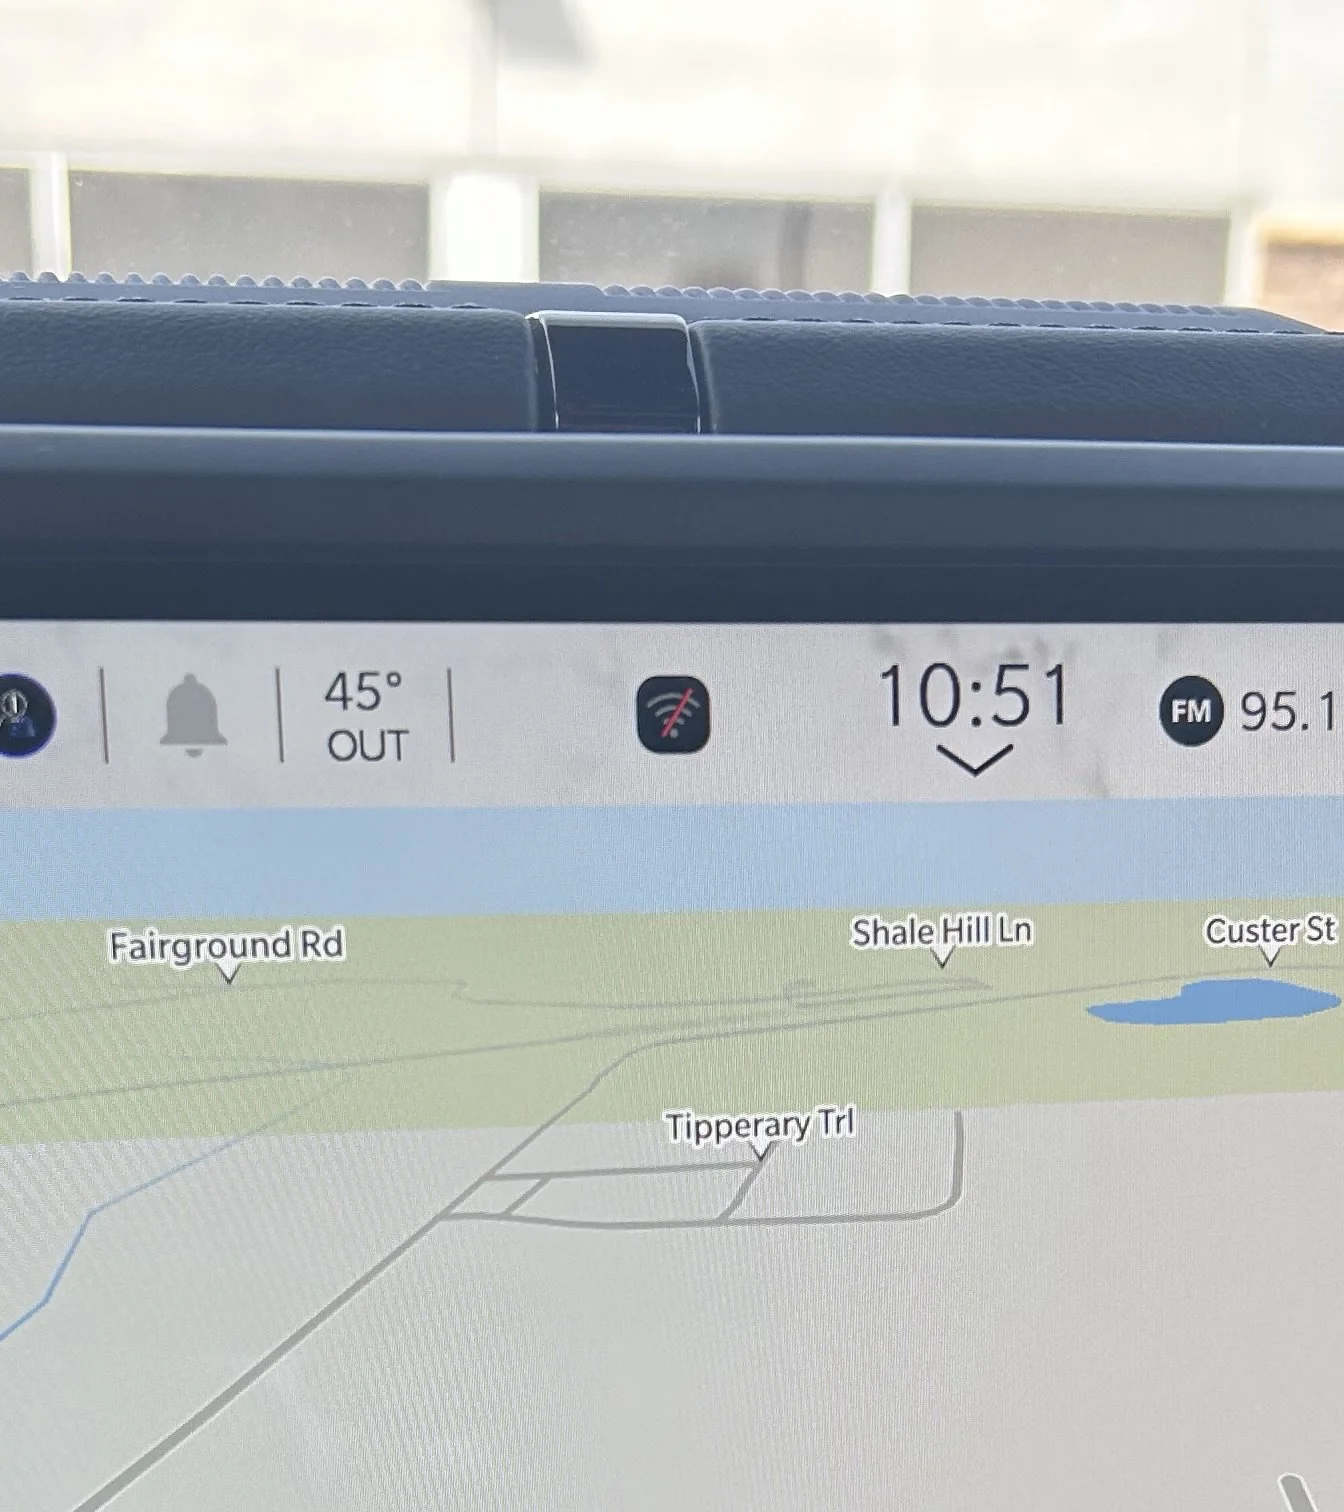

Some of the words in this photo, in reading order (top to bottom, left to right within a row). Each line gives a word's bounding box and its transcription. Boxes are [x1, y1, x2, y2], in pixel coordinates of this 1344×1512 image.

[880, 662, 1067, 728] 10:51
[1171, 700, 1211, 724] FM
[1240, 690, 1336, 732] 95.1
[327, 729, 409, 762] OUT
[854, 919, 934, 946] Shale
[943, 918, 990, 945] Hill
[999, 918, 1032, 943] Ln
[1206, 918, 1300, 944] Custer
[1307, 916, 1336, 942] St
[110, 931, 291, 966] Fairground
[301, 930, 343, 958] Rd
[667, 1111, 811, 1143] Tipperary
[819, 1108, 854, 1136] Trl
